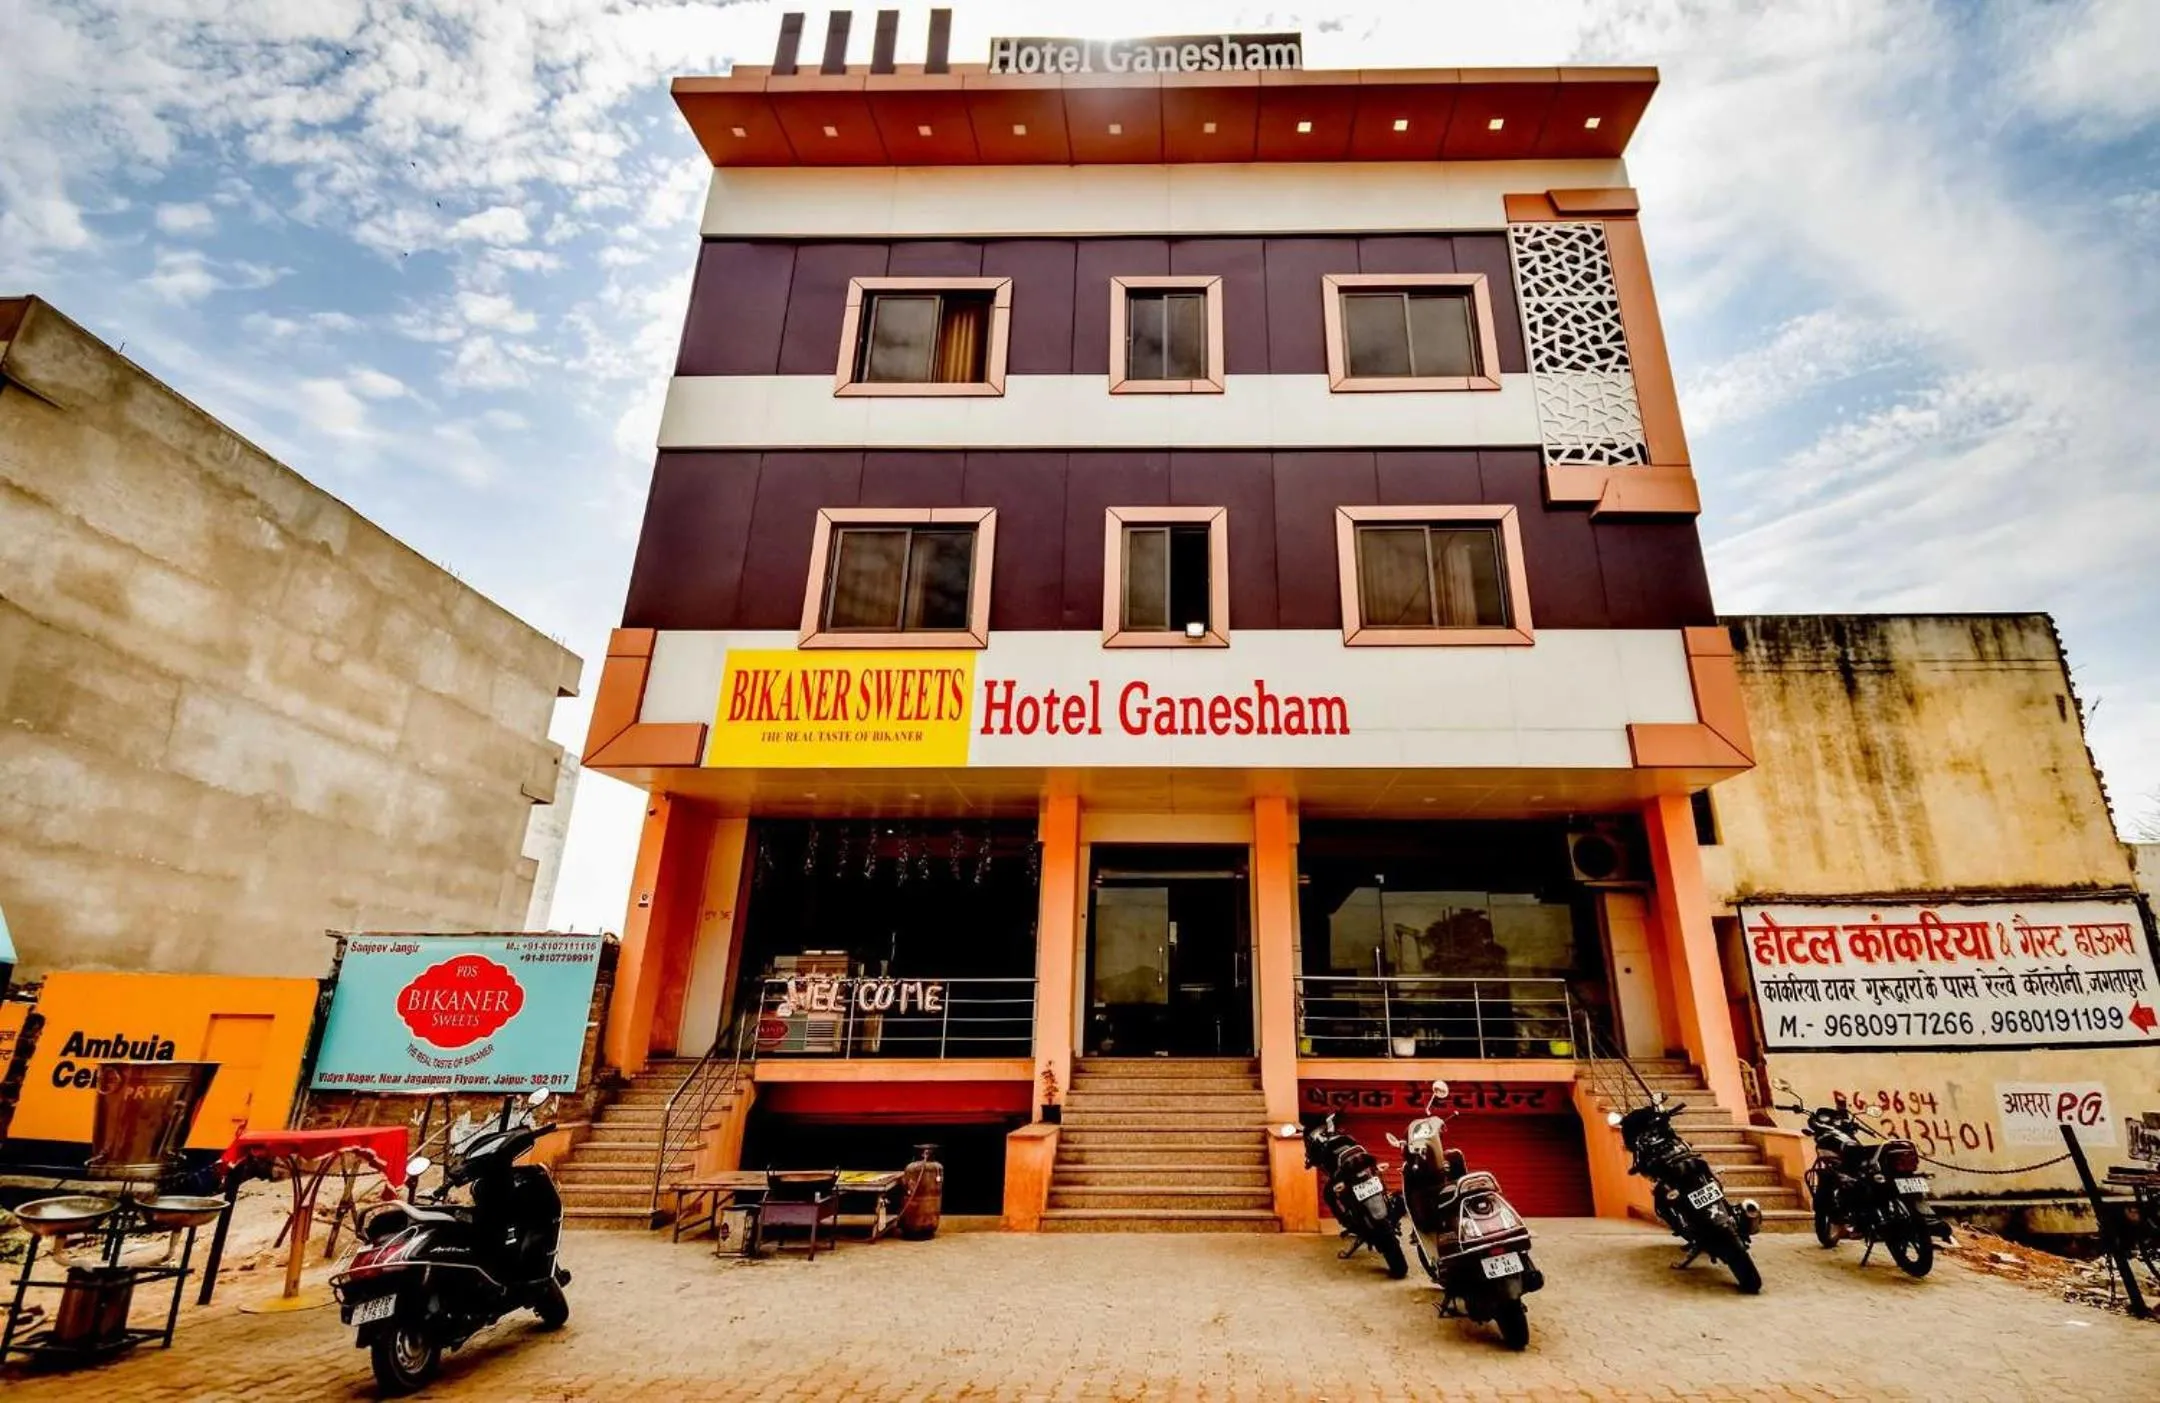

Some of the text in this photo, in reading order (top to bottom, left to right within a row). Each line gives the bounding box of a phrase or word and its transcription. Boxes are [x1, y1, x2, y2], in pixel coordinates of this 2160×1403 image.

[990, 34, 1300, 73] Hotel Ganesham
[728, 668, 965, 721] BIKANER SWEETS
[980, 679, 1350, 736] Hotel Ganesham
[761, 731, 923, 743] THE REAL TASTE OF BIKANER
[351, 941, 420, 955] Sanjeev Jangir
[1748, 911, 1842, 965] होटल
[1843, 910, 1995, 963] कांकरिया
[1996, 922, 2016, 958] &
[407, 989, 510, 1011] BIKANER
[1821, 979, 1860, 1001] टावर
[1940, 975, 1978, 999] पास
[431, 1012, 481, 1026] SWEETS
[1991, 1006, 2123, 1033] 9680191199
[320, 1073, 344, 1083] Vidya
[380, 1073, 402, 1083] Near
[2003, 1092, 2053, 1118] आसरा
